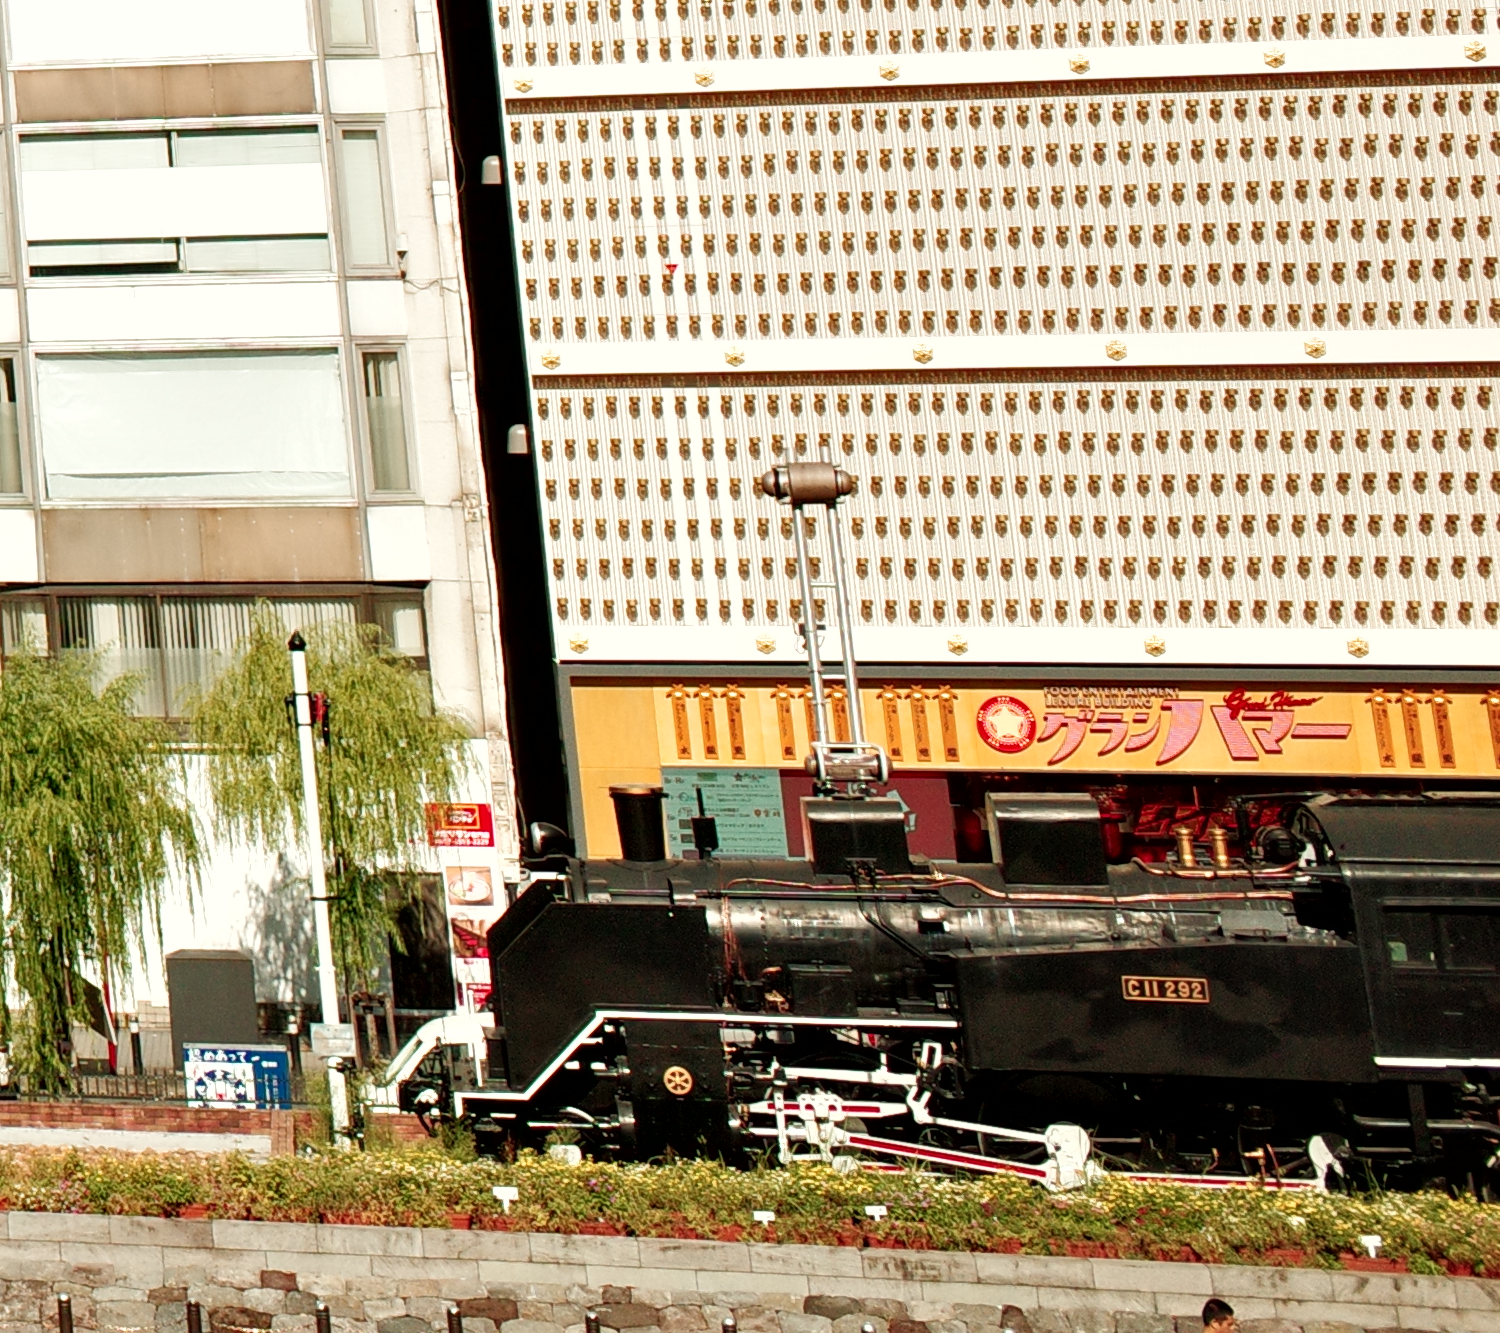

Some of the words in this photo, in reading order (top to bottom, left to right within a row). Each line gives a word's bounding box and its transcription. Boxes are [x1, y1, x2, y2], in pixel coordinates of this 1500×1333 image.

[1037, 699, 1352, 766] グランハマー
[1163, 981, 1204, 999] 292
